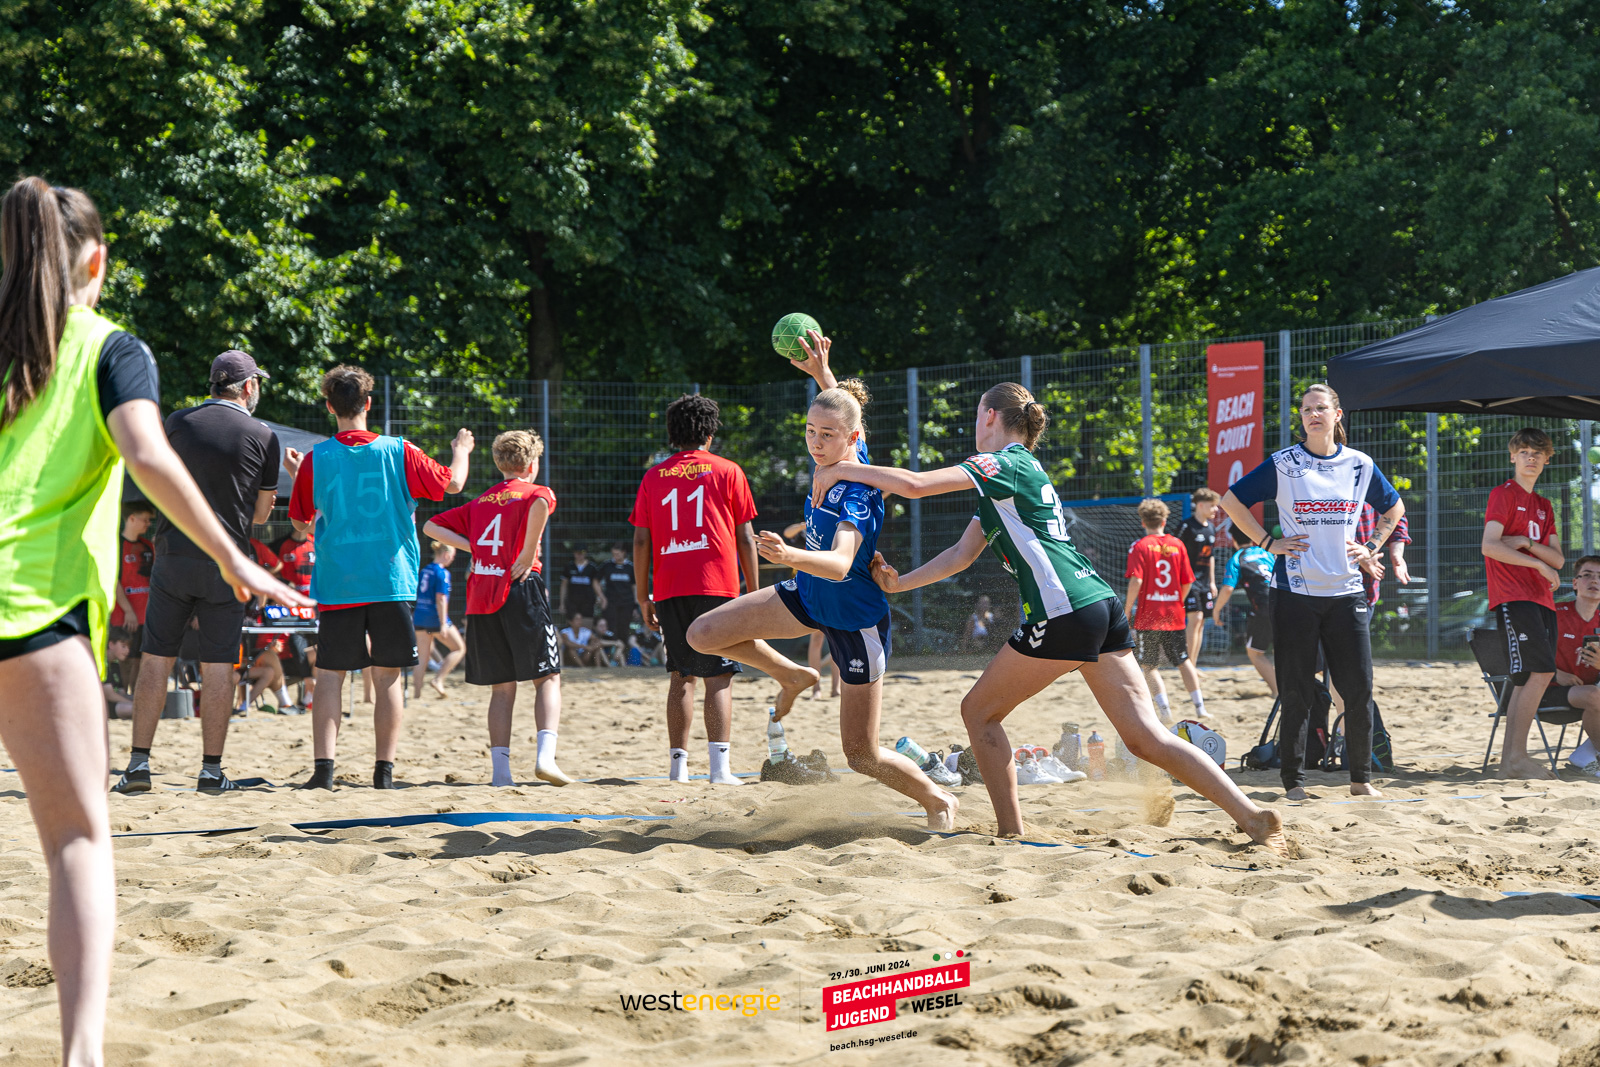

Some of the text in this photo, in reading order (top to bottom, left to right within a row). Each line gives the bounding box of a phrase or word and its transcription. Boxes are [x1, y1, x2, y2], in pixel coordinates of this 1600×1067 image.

[1216, 391, 1255, 424] BEACH
[1216, 422, 1255, 454] COURT
[326, 471, 387, 520] 15
[661, 484, 704, 531] 11
[476, 513, 504, 556] 4
[1155, 559, 1172, 588] 3
